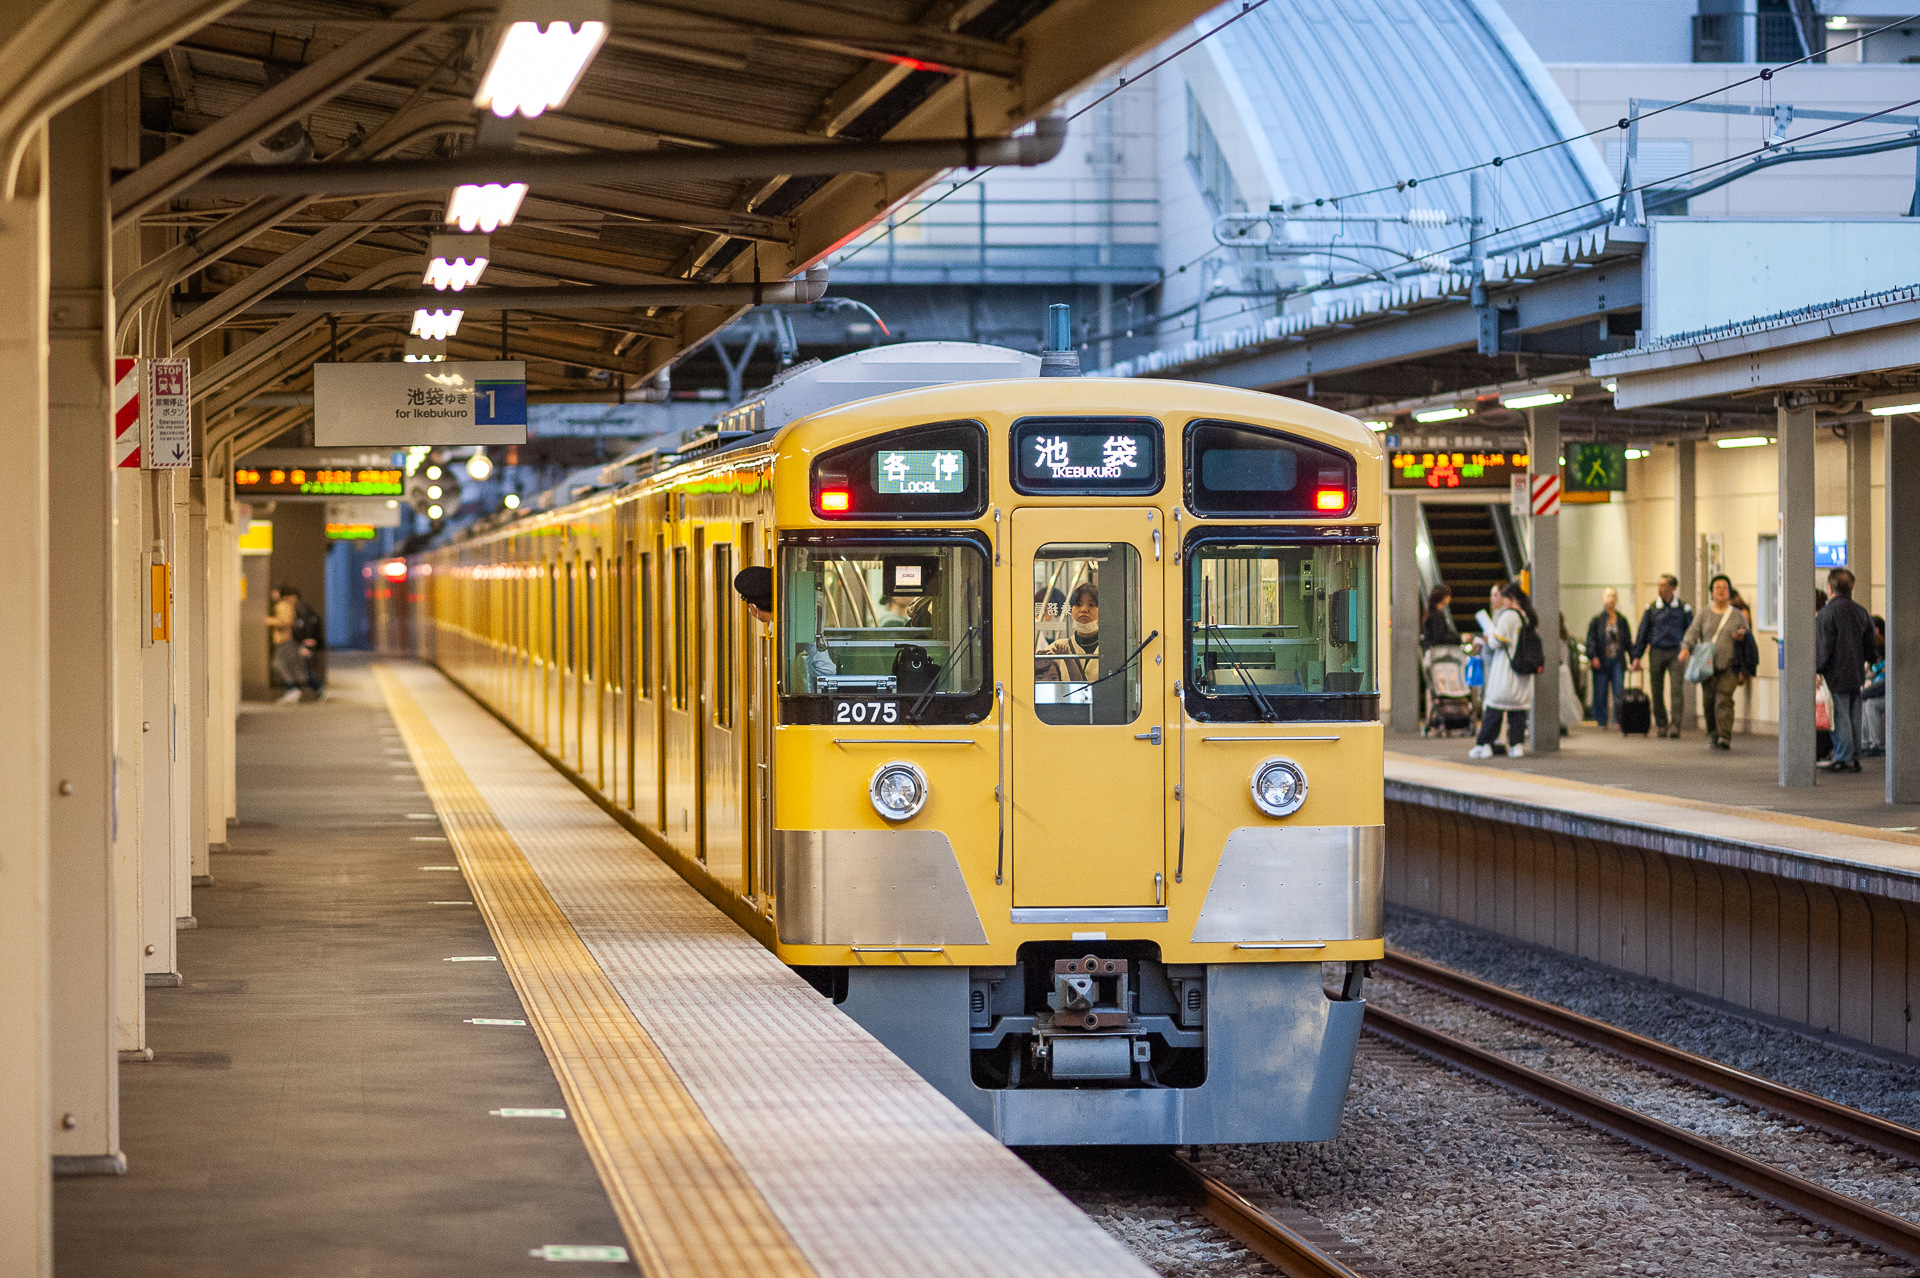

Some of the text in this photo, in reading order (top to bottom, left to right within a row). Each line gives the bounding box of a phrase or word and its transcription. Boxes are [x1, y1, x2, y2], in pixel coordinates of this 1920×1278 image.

[157, 366, 182, 375] STOP
[407, 387, 468, 406] 池袋ゆき
[485, 389, 496, 419] 1
[162, 408, 184, 417] ボタン
[395, 408, 468, 419] for Ikebukuro
[1034, 435, 1138, 468] 池袋
[882, 451, 960, 481] 各停
[1051, 466, 1122, 478] IKEBUKURO
[899, 481, 941, 493] LOCAL
[836, 702, 898, 723] 2075
